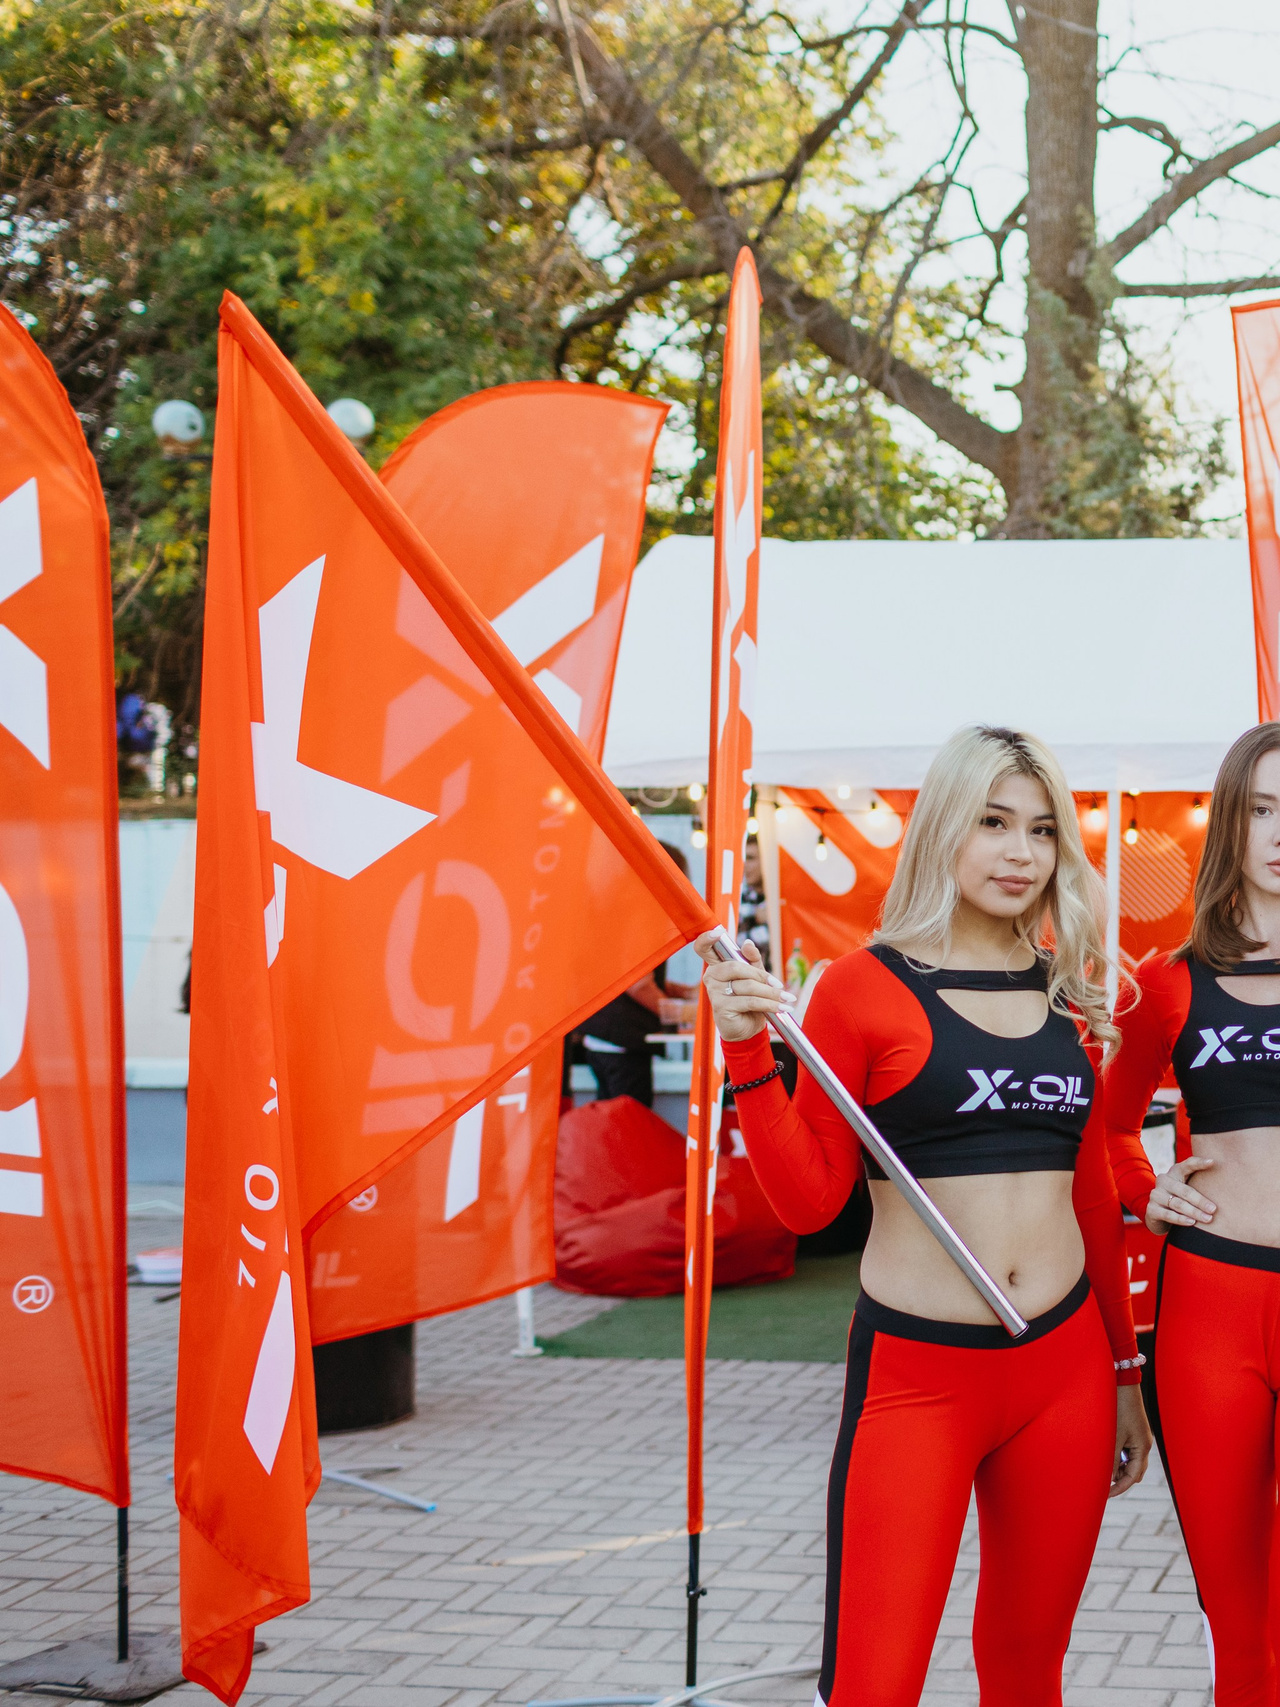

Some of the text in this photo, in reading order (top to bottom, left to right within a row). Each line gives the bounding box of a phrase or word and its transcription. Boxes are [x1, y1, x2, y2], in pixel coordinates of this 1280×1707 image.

[955, 1069, 1090, 1113] X-OIL
[1011, 1102, 1076, 1114] MOTOR OIL
